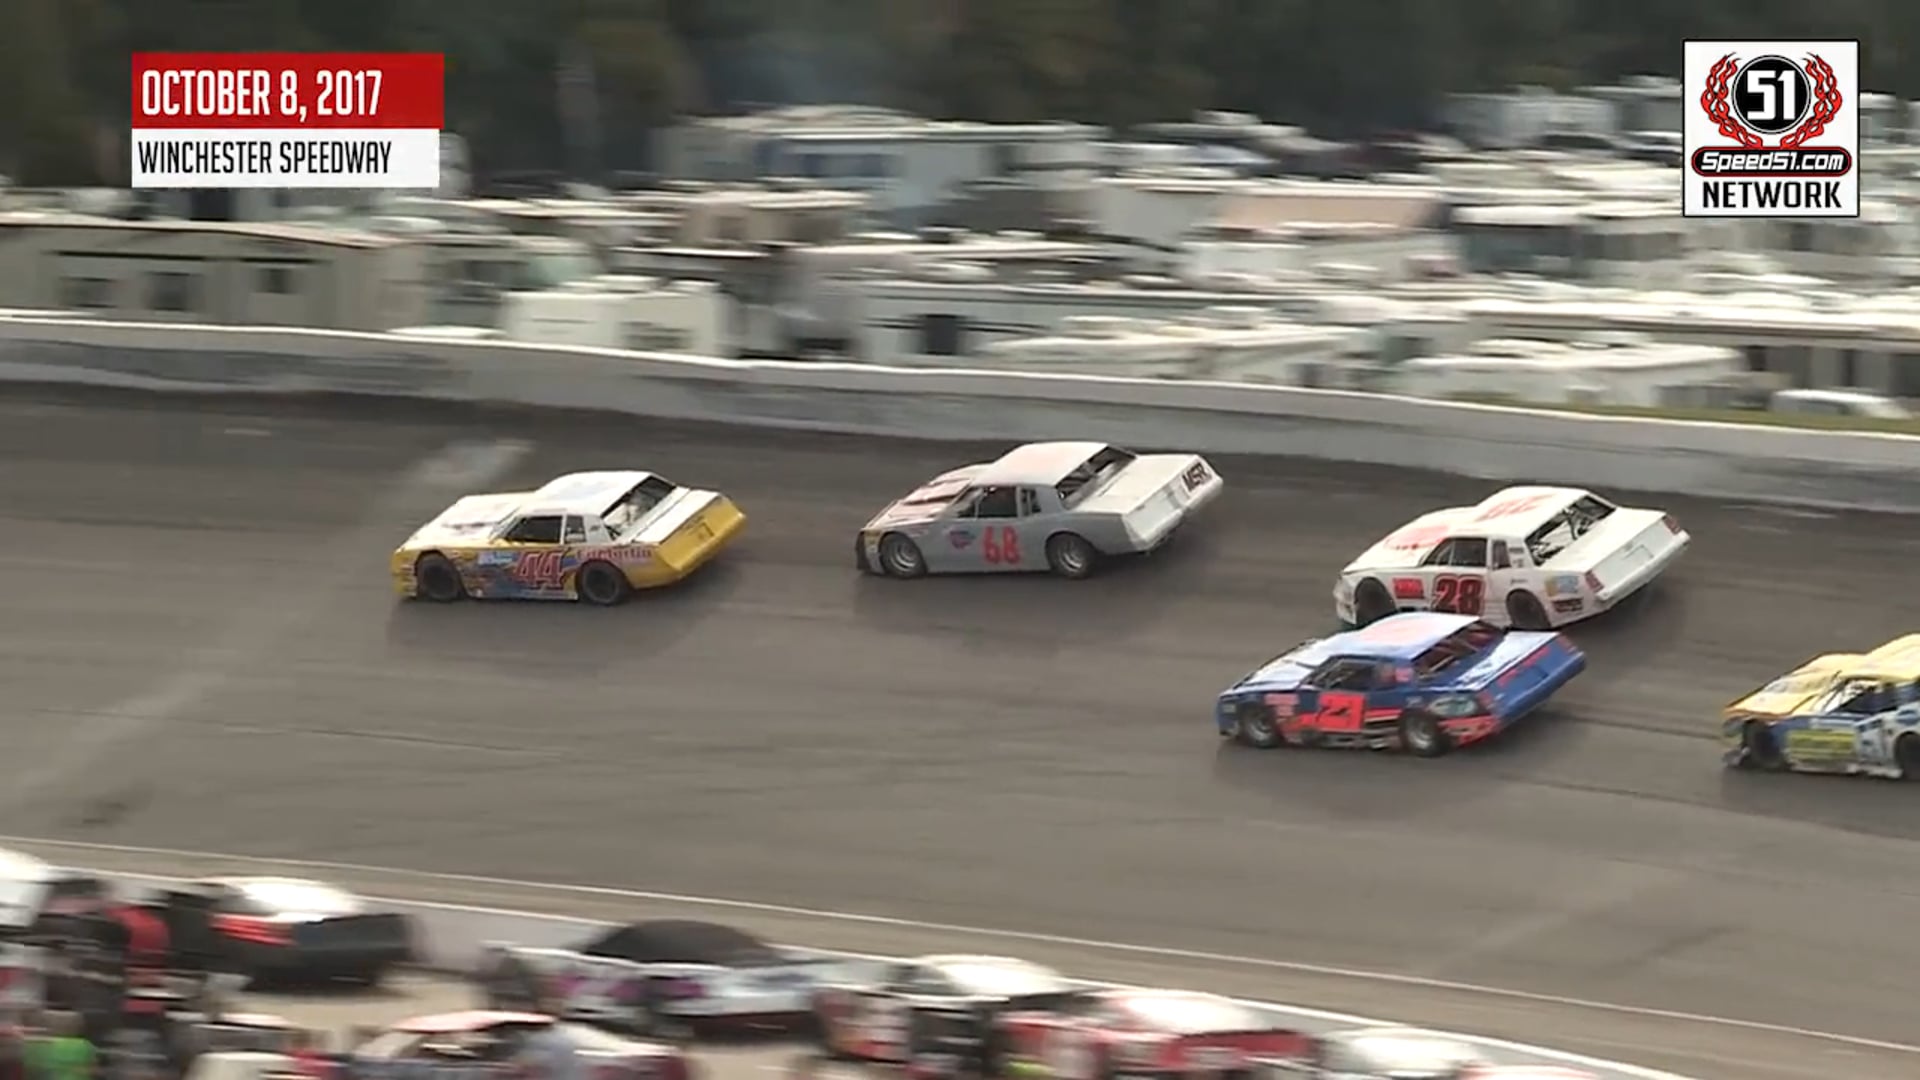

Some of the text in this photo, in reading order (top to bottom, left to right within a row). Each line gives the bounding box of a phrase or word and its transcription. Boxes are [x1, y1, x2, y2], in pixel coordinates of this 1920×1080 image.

[982, 526, 1021, 564] 68
[514, 550, 565, 590] 44
[1432, 573, 1484, 615] 28
